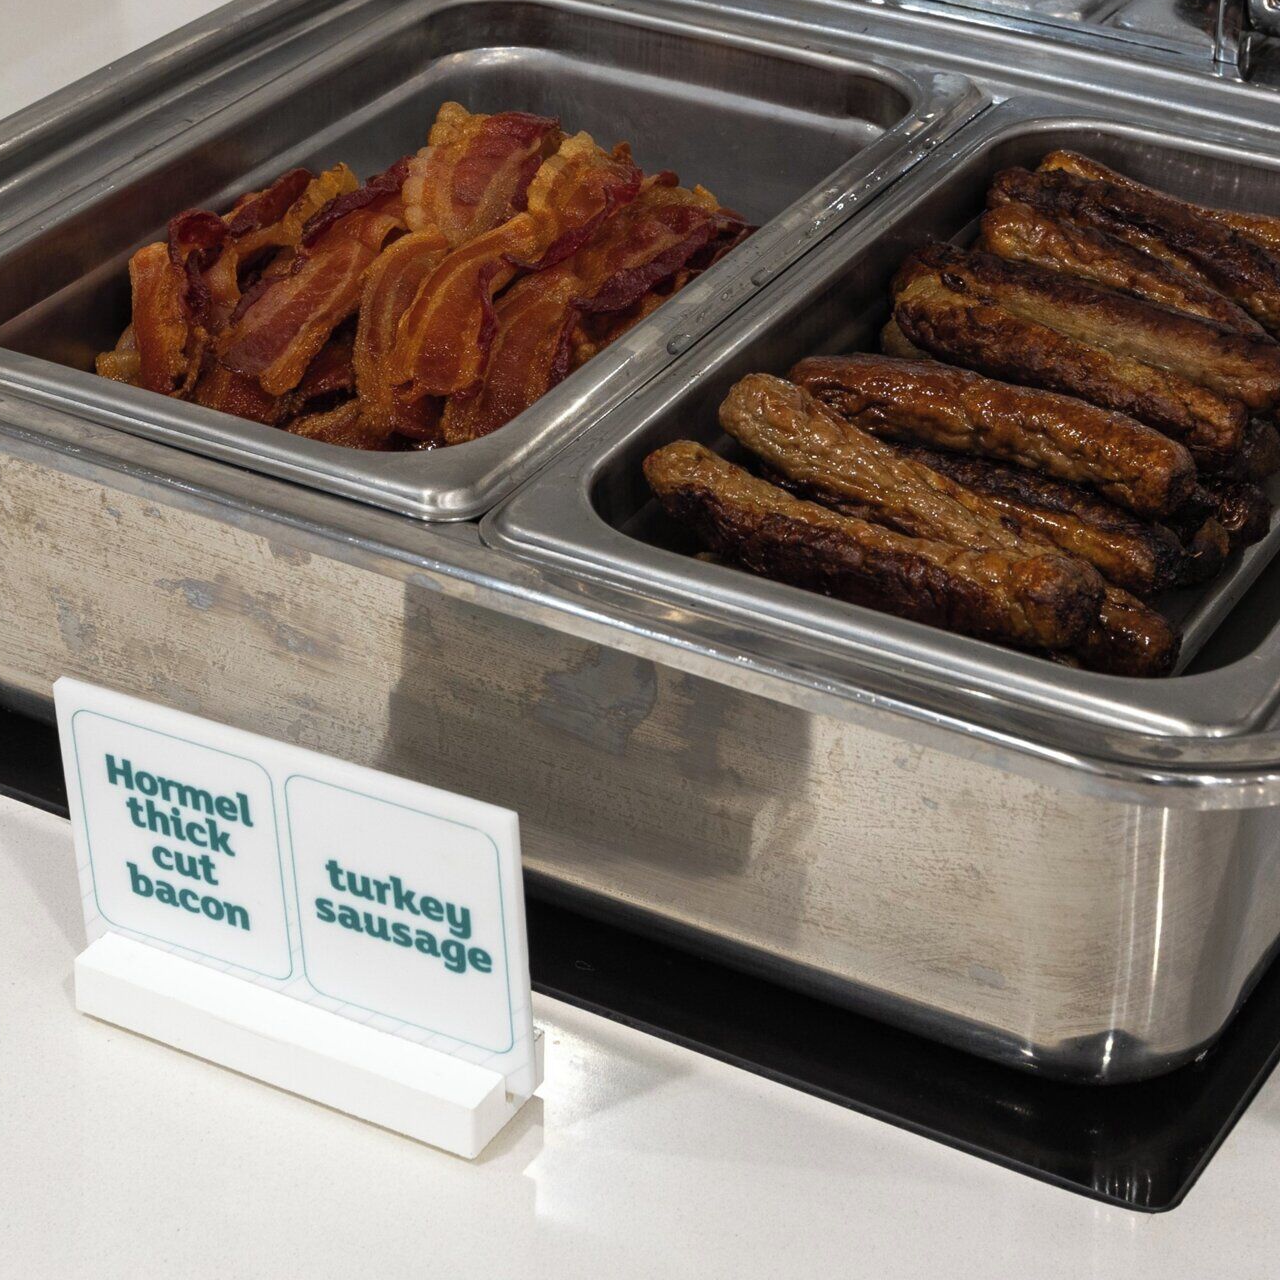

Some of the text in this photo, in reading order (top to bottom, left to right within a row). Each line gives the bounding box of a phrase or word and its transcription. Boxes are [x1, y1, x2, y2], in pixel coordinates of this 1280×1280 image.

[105, 753, 254, 828] Hormel
[125, 796, 235, 857] thick
[126, 861, 251, 931] bacon
[151, 845, 219, 886] cut
[324, 859, 472, 939] turkey
[314, 897, 493, 974] sausage
